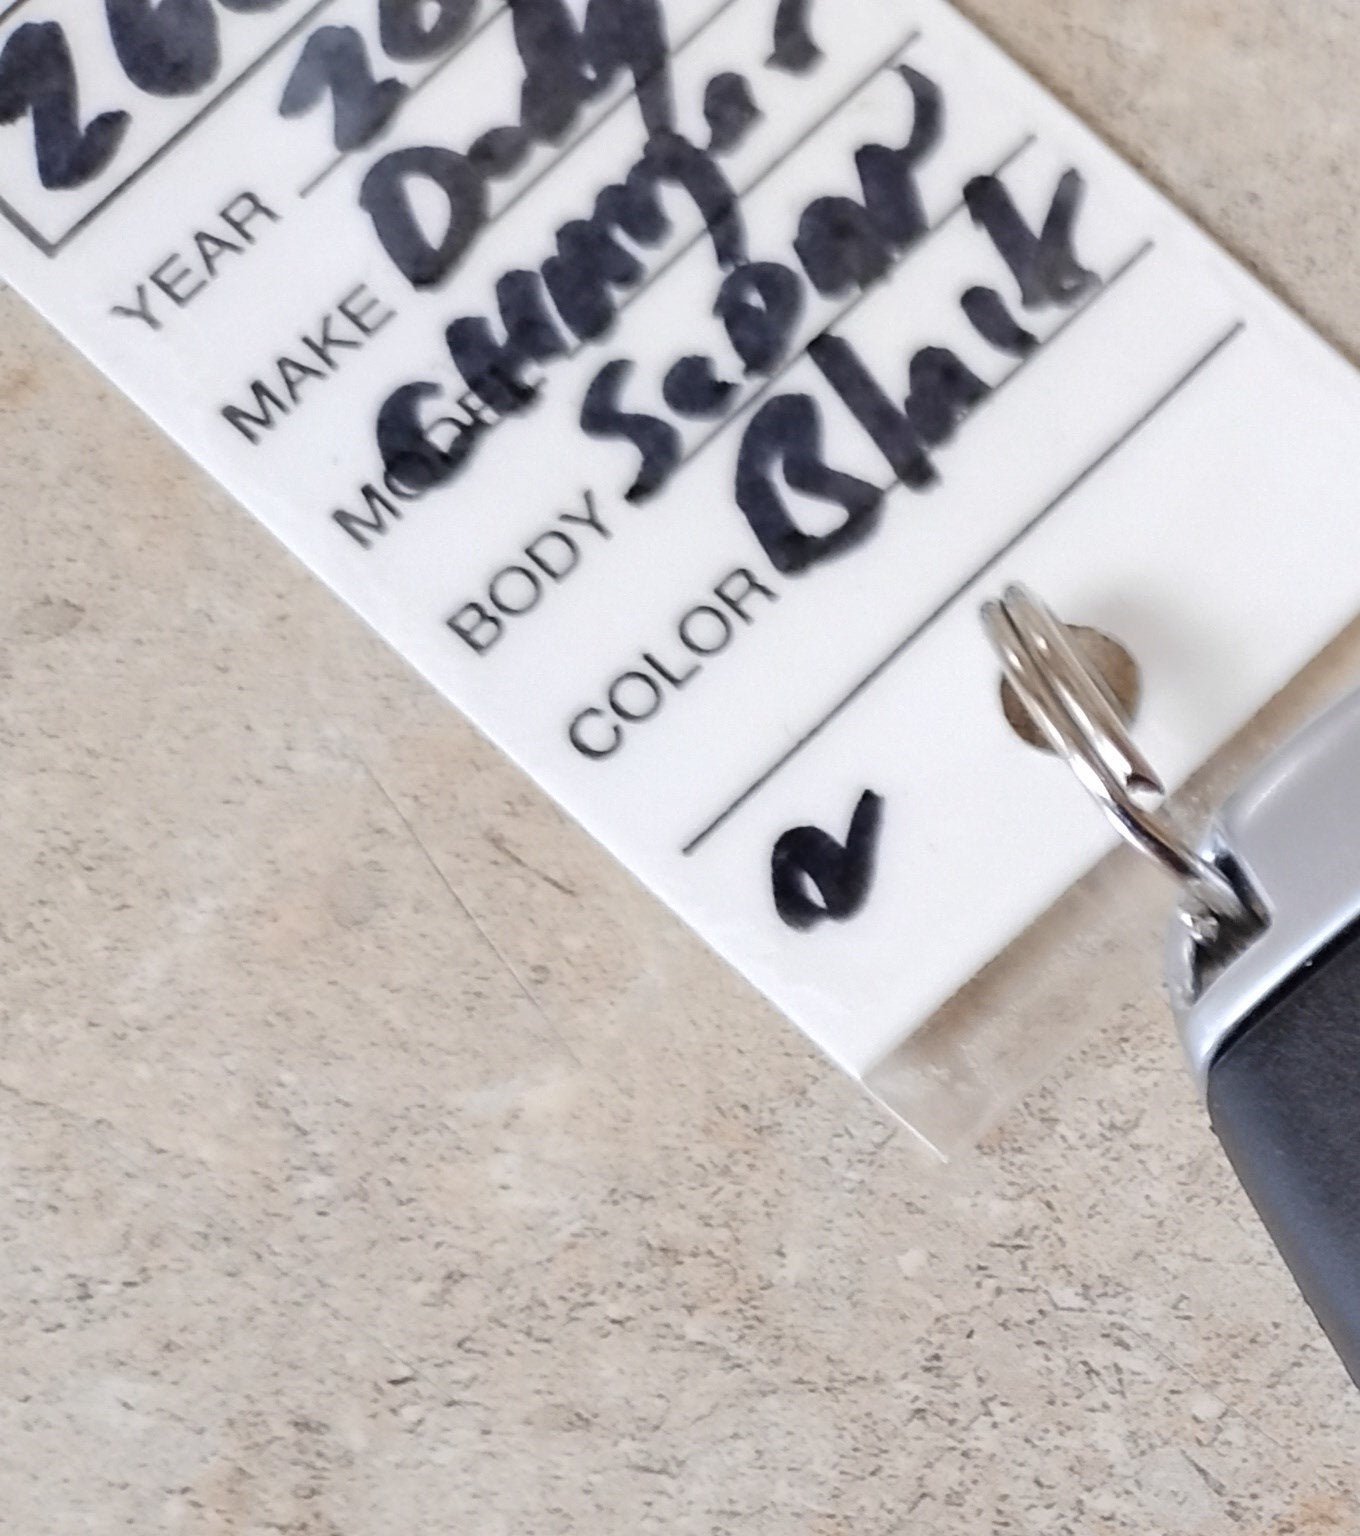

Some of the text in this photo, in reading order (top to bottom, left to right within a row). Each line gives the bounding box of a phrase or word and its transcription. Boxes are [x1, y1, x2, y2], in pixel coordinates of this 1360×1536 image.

[112, 190, 282, 331] YEAR
[221, 283, 398, 446] MAKE
[445, 489, 613, 656] BODY
[568, 567, 780, 762] COLOR
